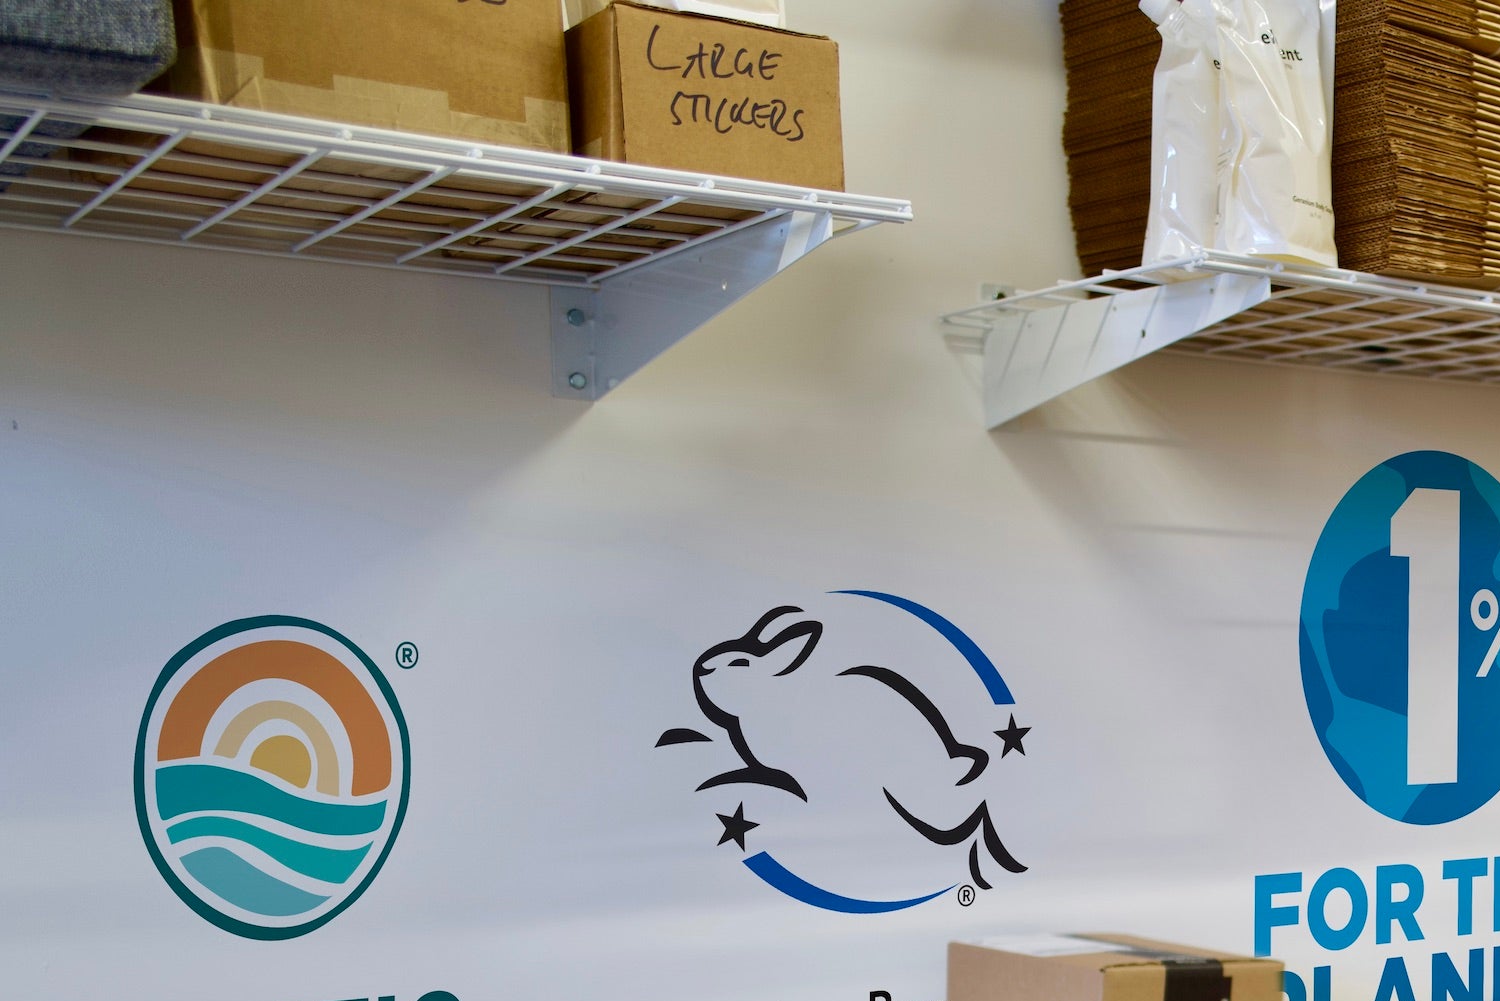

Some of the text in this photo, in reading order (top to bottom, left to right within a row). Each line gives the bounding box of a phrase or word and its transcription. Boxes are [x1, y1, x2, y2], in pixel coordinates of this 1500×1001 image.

[646, 24, 783, 81] LARGE
[670, 90, 805, 142] STICKERS
[1254, 863, 1425, 958] FOR
